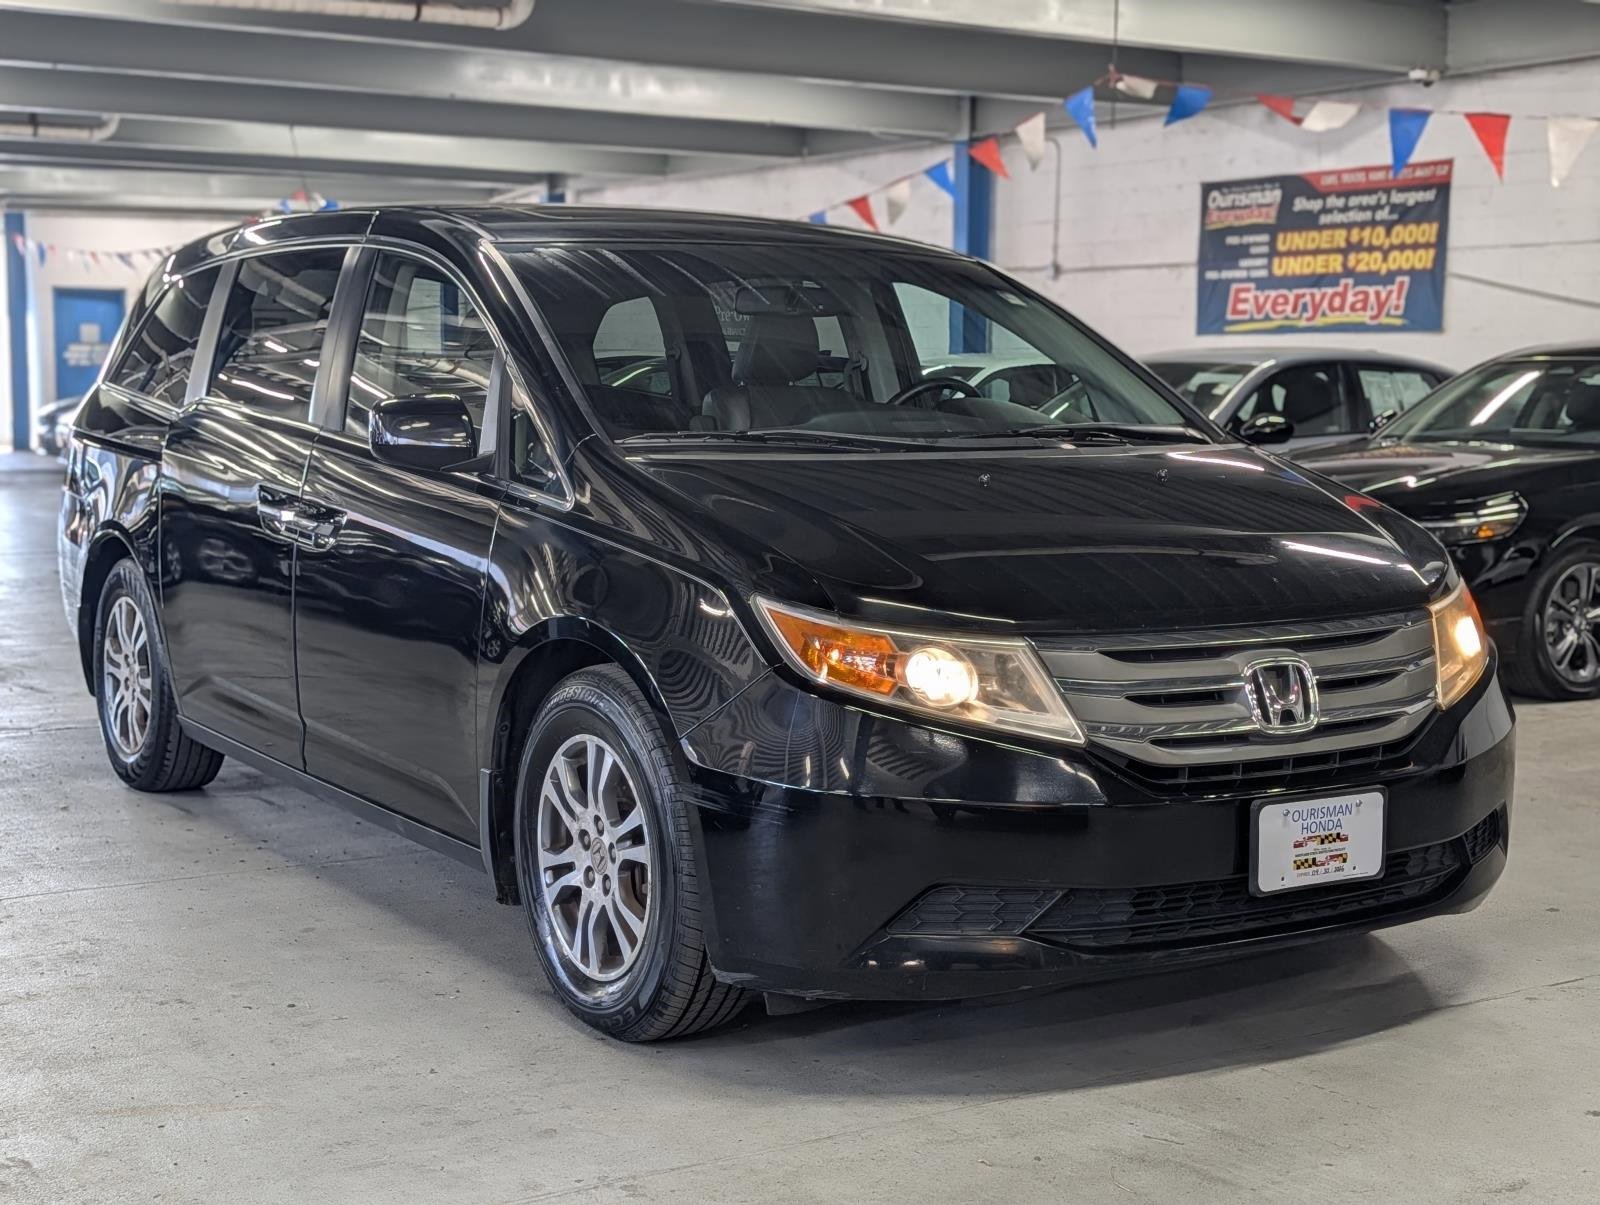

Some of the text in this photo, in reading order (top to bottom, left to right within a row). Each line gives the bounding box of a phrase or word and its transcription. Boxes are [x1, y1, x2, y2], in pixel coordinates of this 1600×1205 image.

[1292, 187, 1438, 213] Shop the area's largest
[1318, 208, 1373, 226] selection
[1275, 228, 1348, 252] UNDER
[1349, 222, 1440, 247] $10,000!
[1271, 253, 1344, 278] UNDER
[1347, 247, 1436, 276] $20,000!
[1226, 276, 1410, 326] Everyday!
[1291, 803, 1353, 823] OURISMAN
[1300, 818, 1343, 835] HONDA
